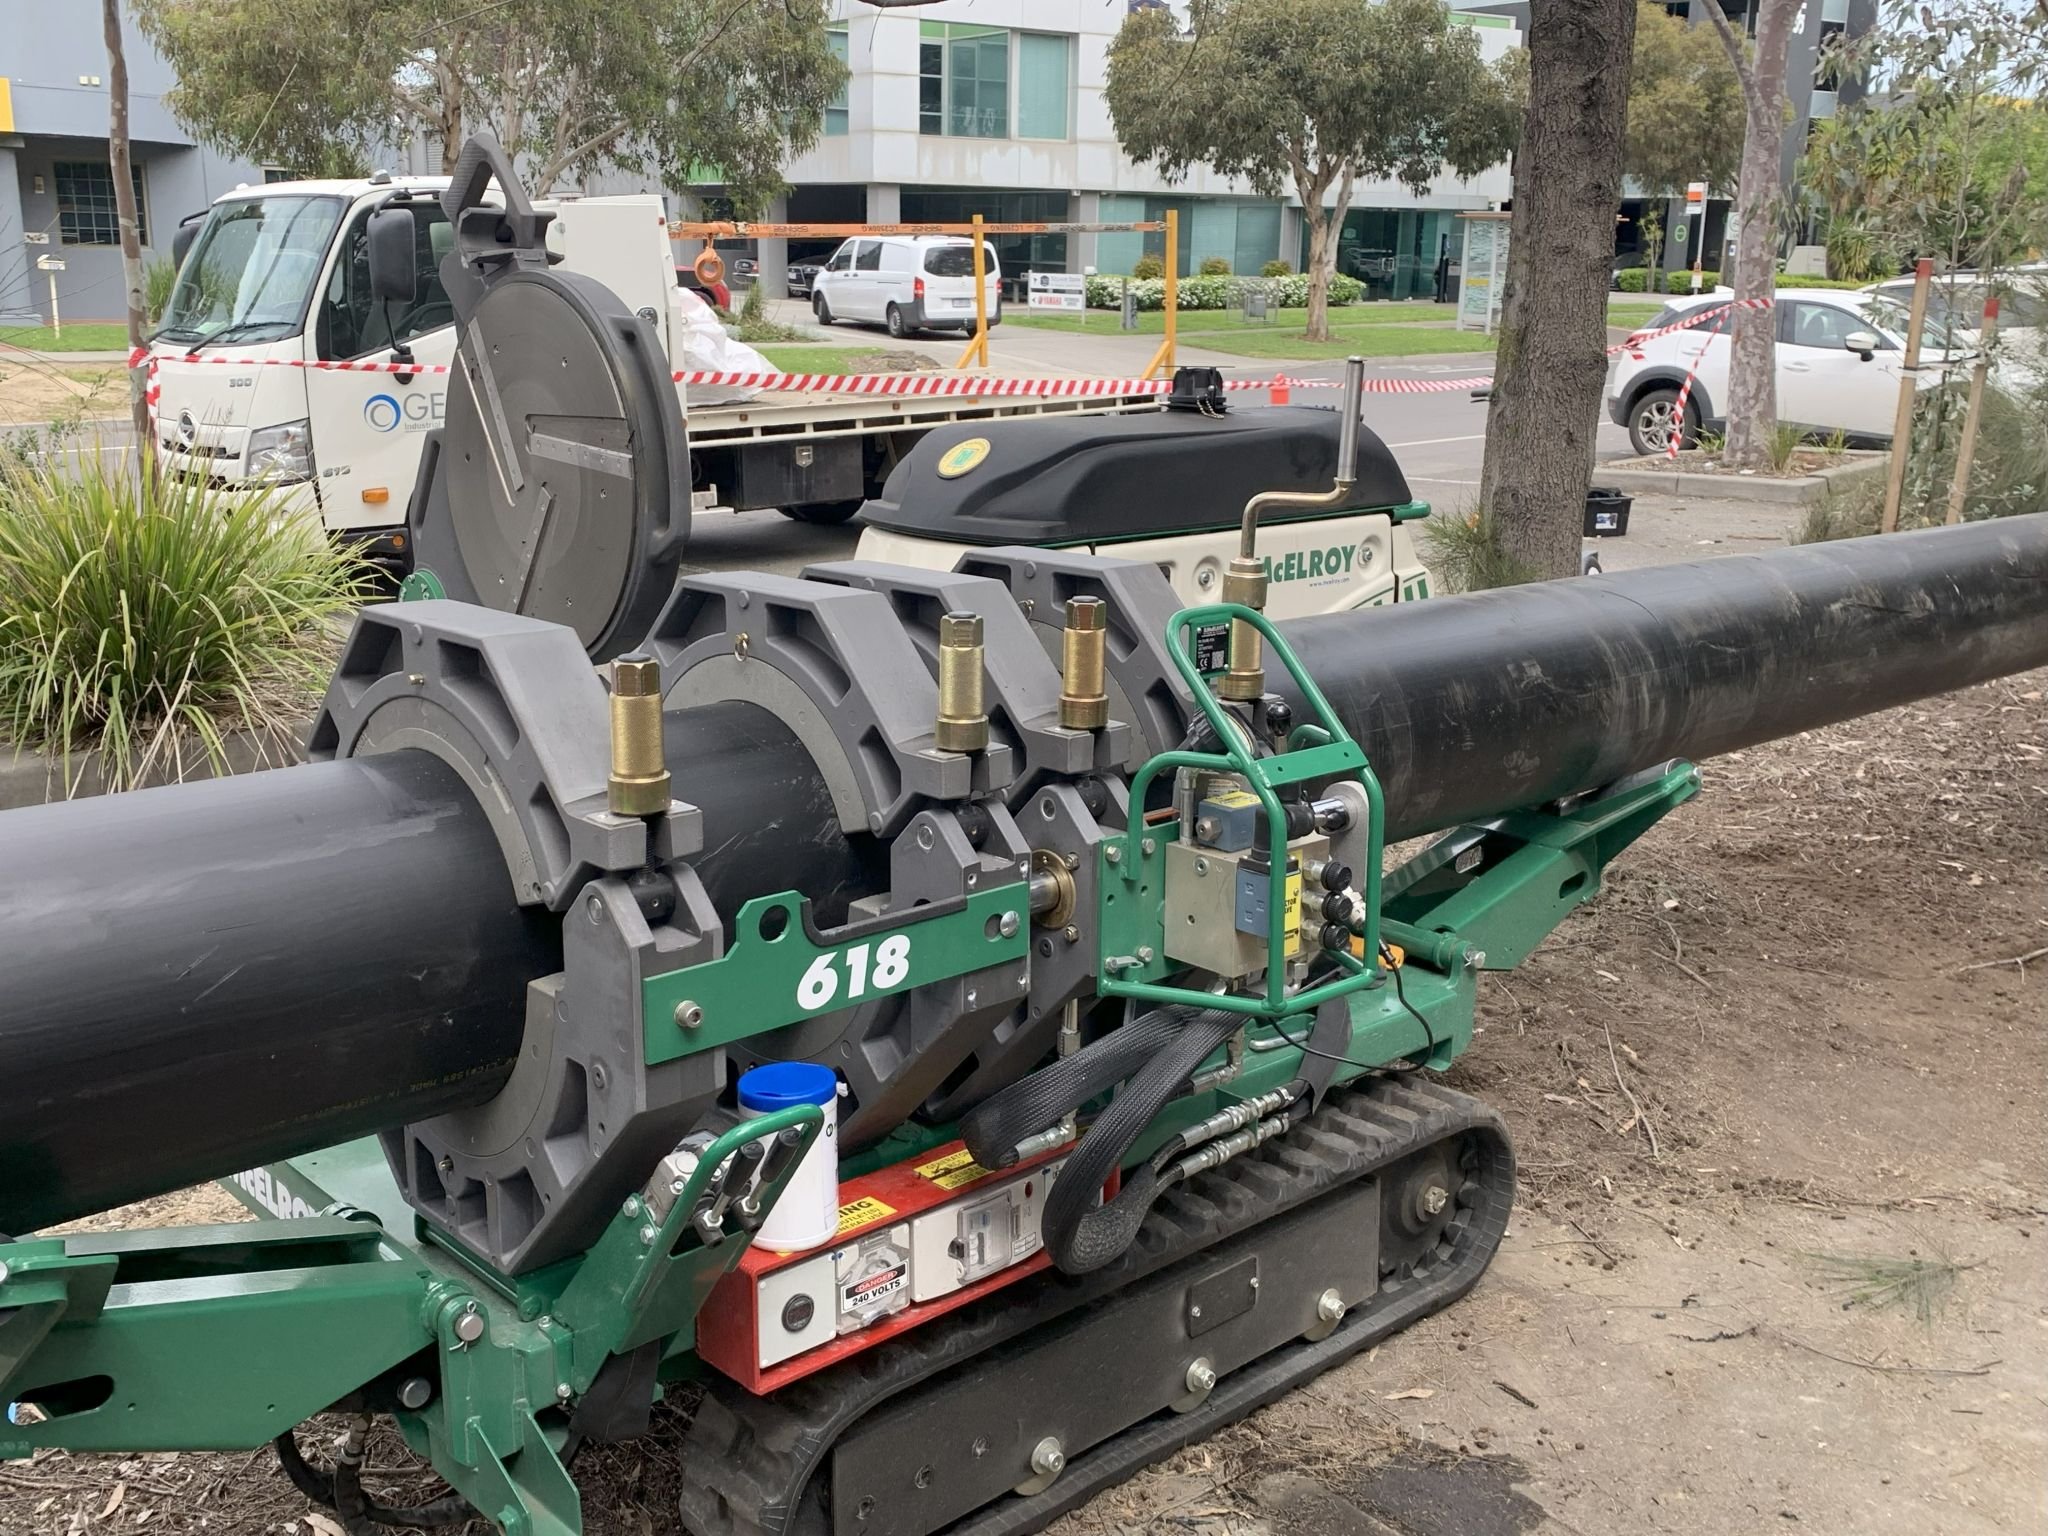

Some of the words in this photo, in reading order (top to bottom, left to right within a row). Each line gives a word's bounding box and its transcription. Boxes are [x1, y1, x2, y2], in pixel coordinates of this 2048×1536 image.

[797, 934, 911, 1010] 618
[839, 1201, 874, 1218] ING
[860, 1272, 893, 1290] DANGER
[852, 1293, 869, 1306] 240
[871, 1279, 901, 1297] VOLTS
